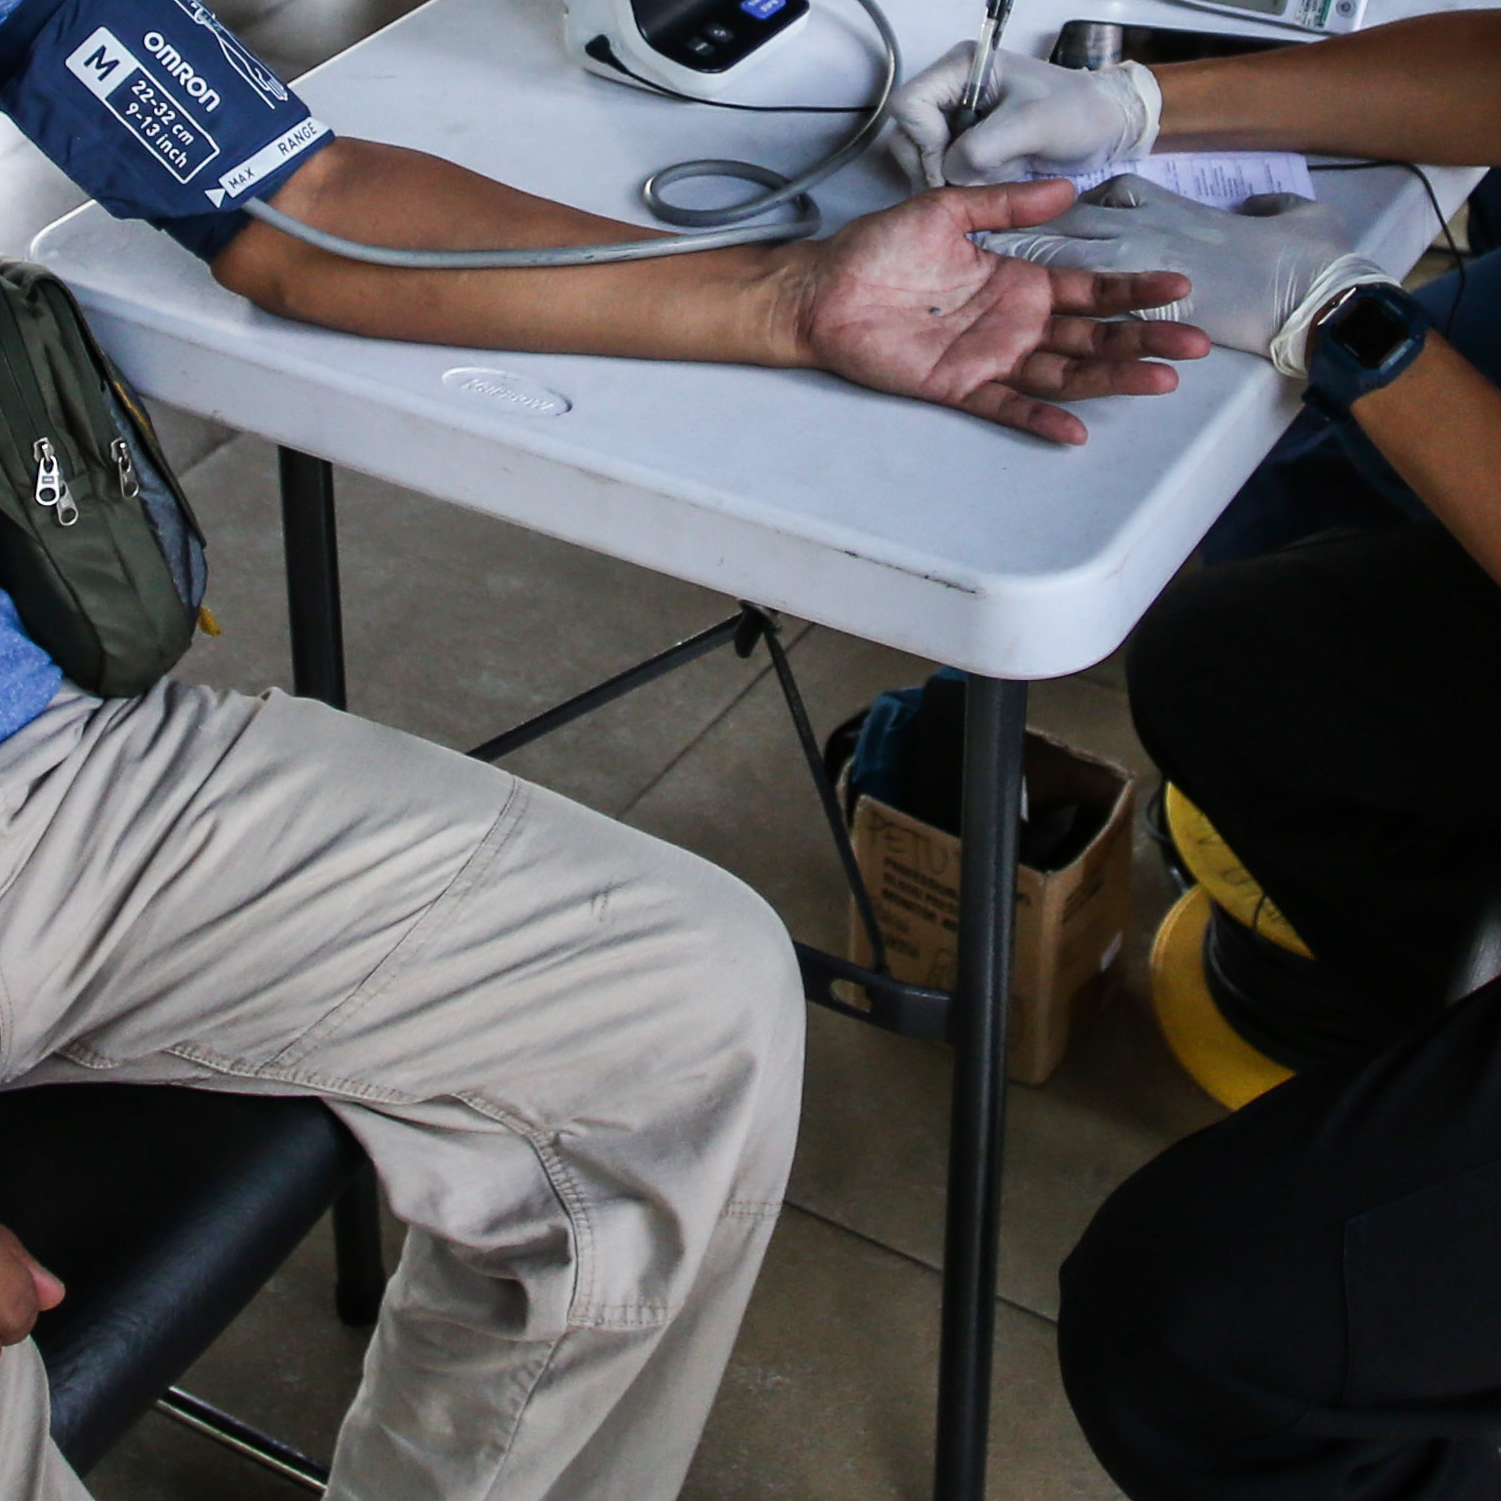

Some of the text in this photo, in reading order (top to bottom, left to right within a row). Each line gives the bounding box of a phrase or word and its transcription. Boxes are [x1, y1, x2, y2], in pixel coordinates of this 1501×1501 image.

[83, 44, 120, 82] M
[143, 32, 221, 112] OMRON
[125, 102, 187, 168] 9-13 inch
[131, 80, 194, 146] 22-32 cm
[228, 122, 317, 189] MAX RANGE
